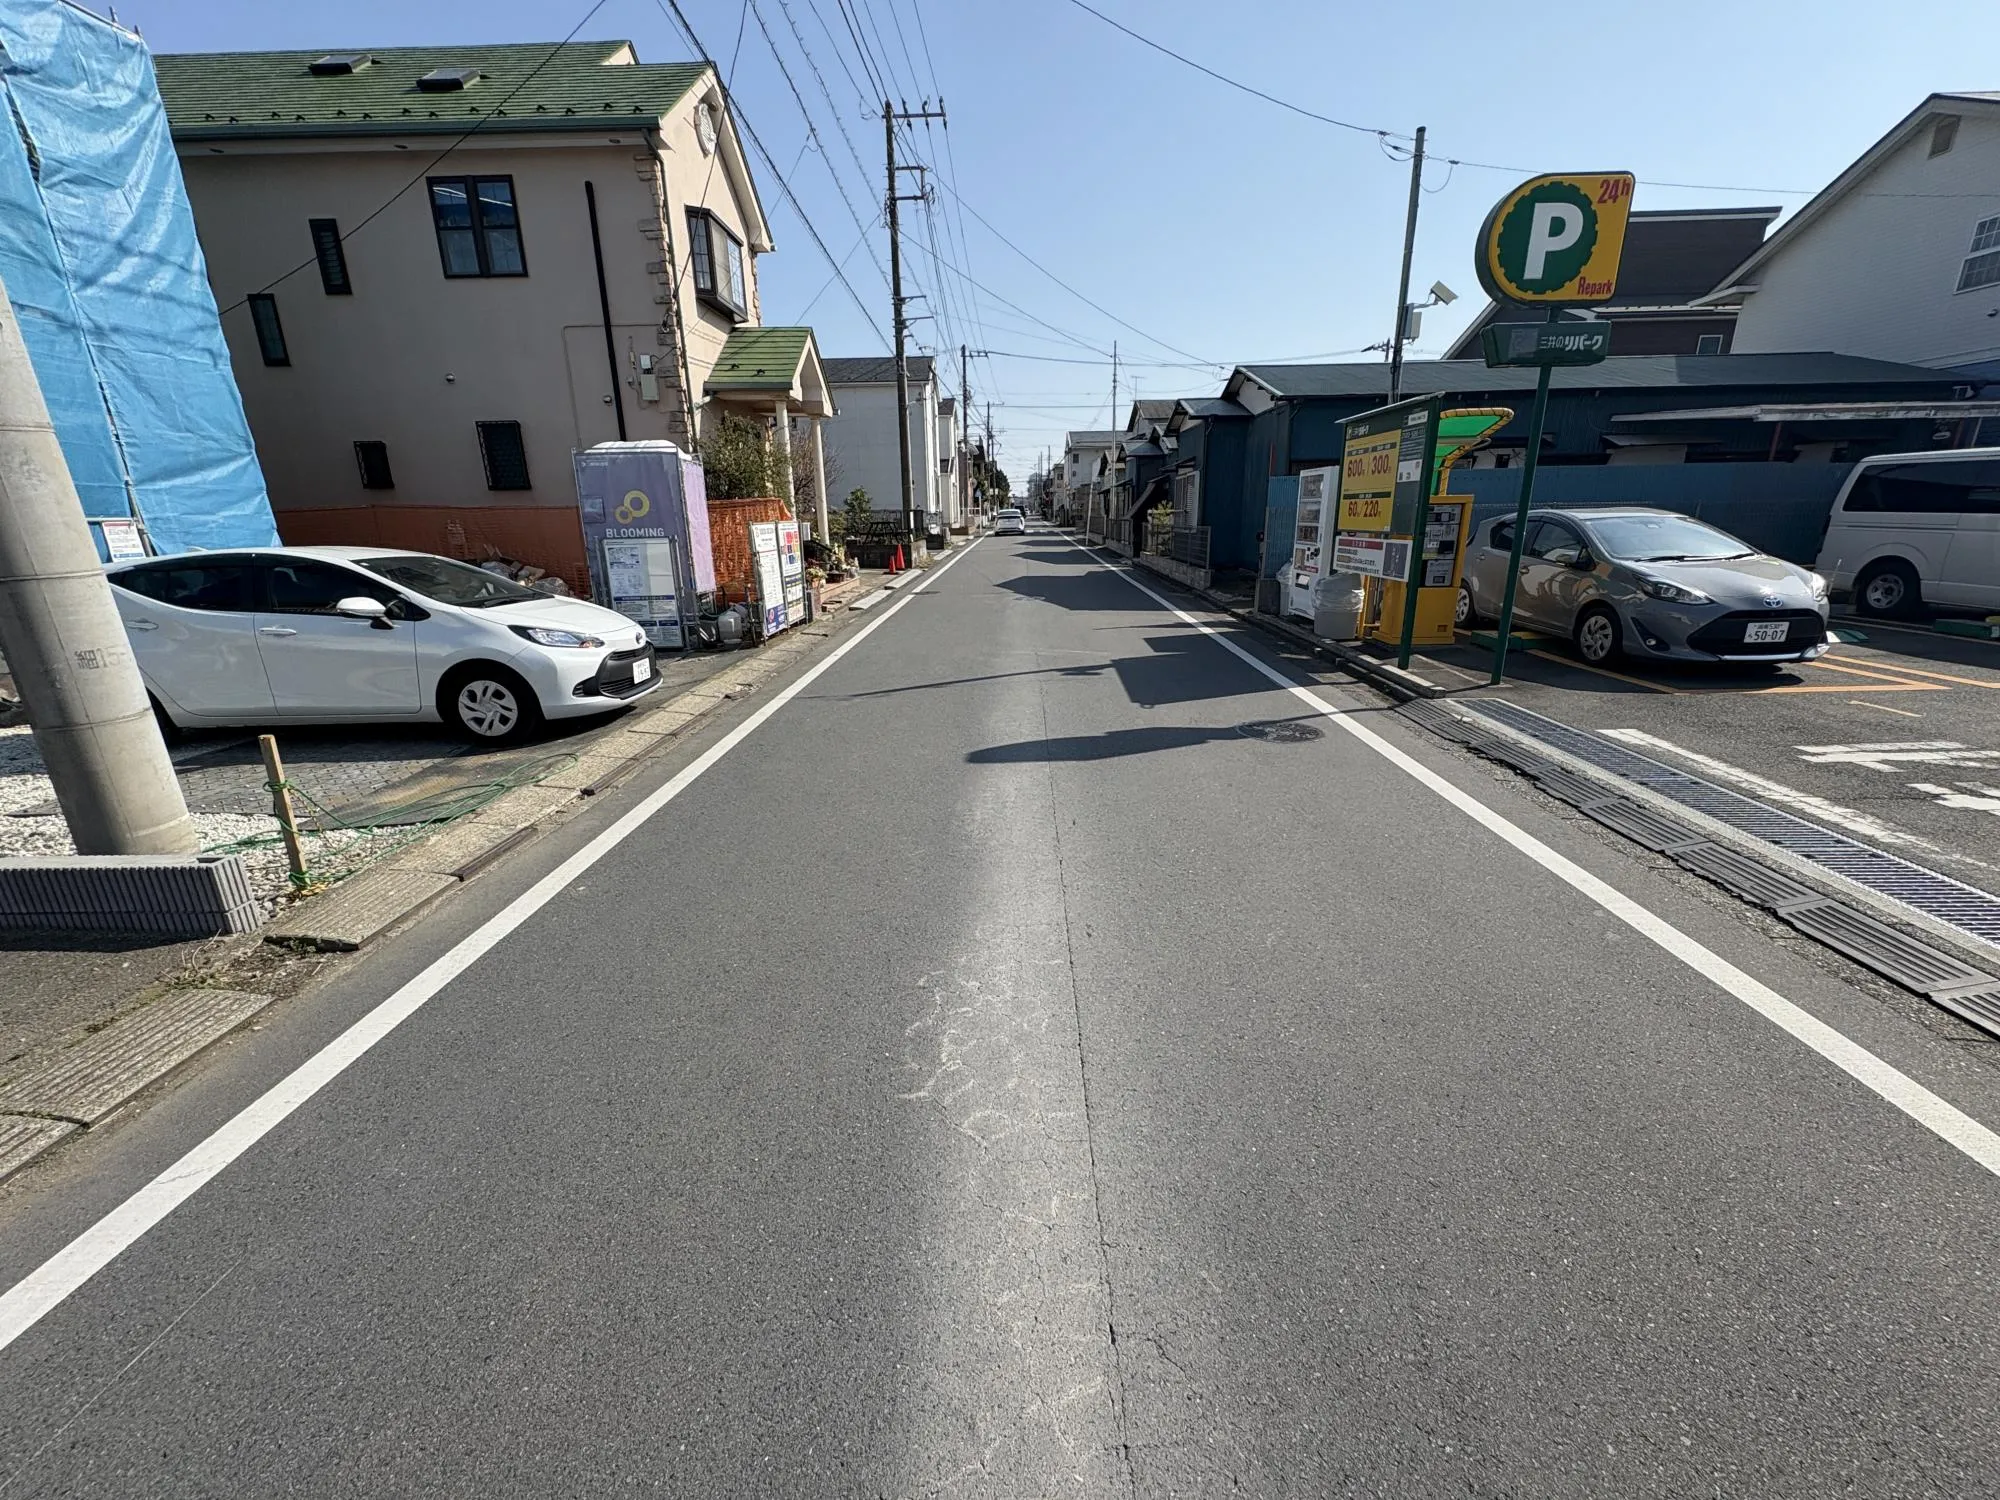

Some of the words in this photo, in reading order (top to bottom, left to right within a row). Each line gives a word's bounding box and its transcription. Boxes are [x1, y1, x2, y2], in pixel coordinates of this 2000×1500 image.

[1598, 179, 1630, 204] 24h
[1523, 202, 1583, 280] P
[1577, 276, 1613, 297] Repark
[1538, 333, 1604, 352] 三井のリパーク
[605, 527, 665, 538] BLOOMING
[1753, 629, 1785, 641] 50-07
